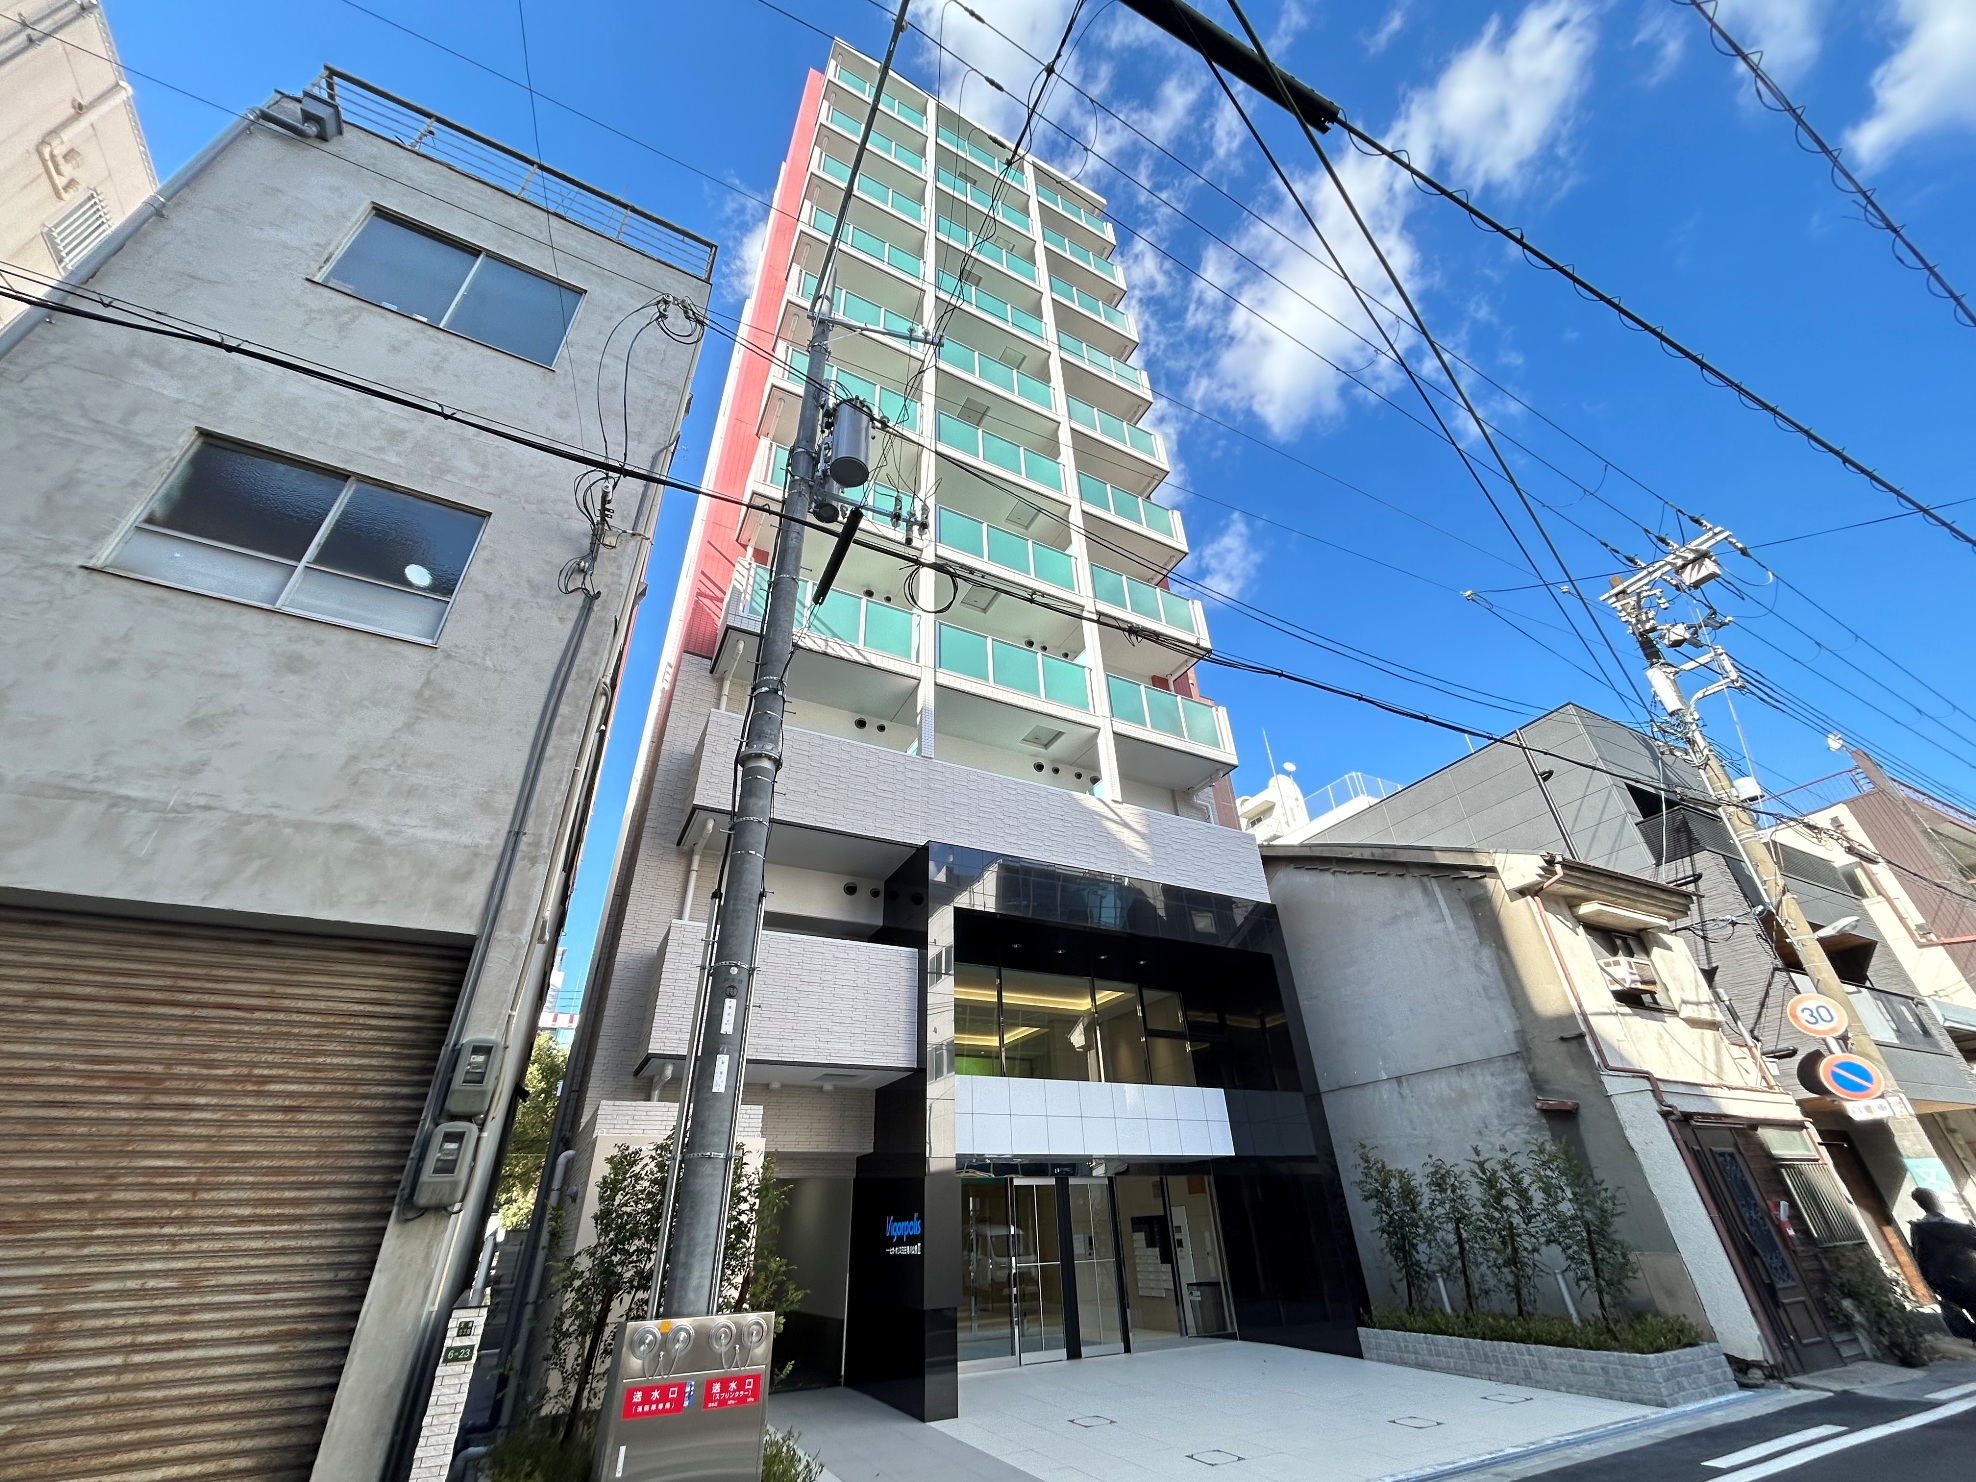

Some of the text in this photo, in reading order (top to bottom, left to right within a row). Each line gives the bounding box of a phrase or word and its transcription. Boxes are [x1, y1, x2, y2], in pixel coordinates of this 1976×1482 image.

[1801, 1005, 1834, 1025] 30
[448, 1349, 470, 1359] 6-23
[711, 1379, 754, 1393] 送水口
[632, 1387, 678, 1403] 送水口
